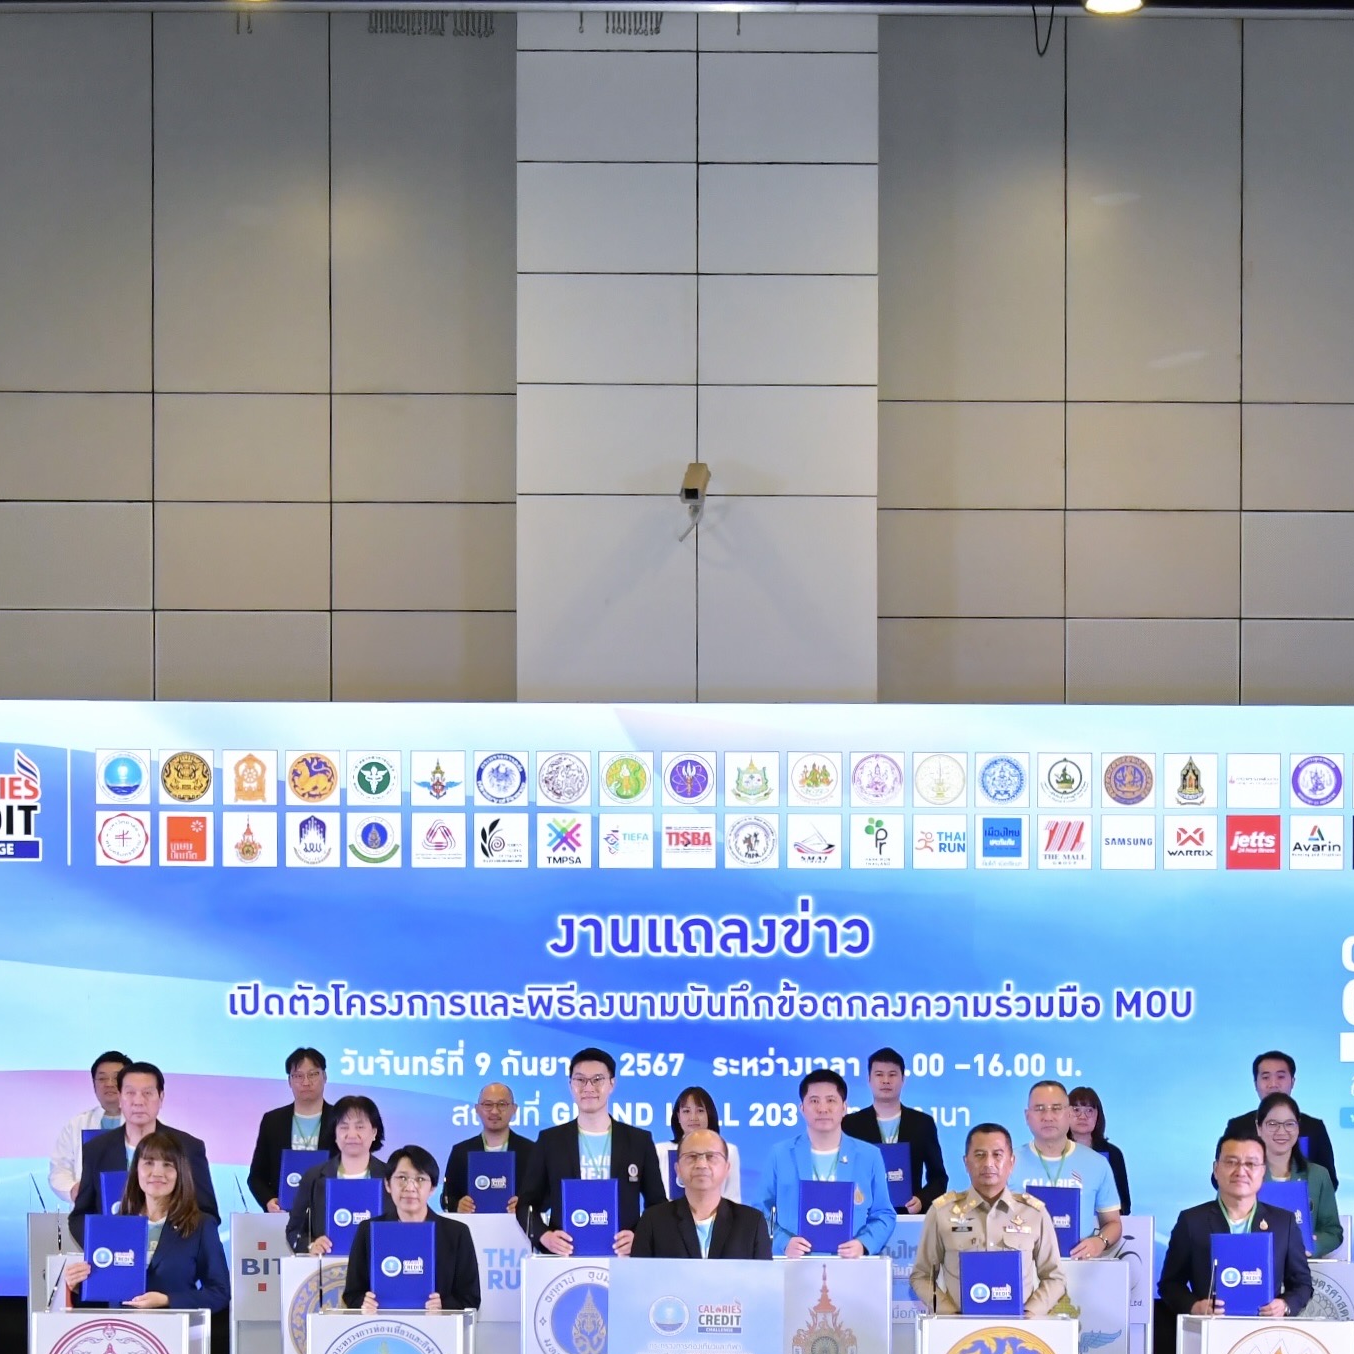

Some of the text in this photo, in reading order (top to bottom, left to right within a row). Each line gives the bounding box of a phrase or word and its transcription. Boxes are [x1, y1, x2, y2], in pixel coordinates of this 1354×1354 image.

[937, 831, 966, 842] THAI
[1104, 837, 1153, 846] SAMSUNG
[1230, 831, 1276, 850] jetts
[938, 842, 966, 853] RUN
[1167, 849, 1213, 857] WARRIX
[1292, 841, 1341, 852] Avarin
[546, 856, 582, 865] TMPSA
[549, 898, 871, 955] งานแถลงข่าว
[228, 980, 1193, 1019] เปิดตัวโครงการและพิธีลงนามบันทึกข้อตกลงความร่วมมือ MOU
[340, 1040, 464, 1077] วันจันทร์ที่
[475, 1053, 491, 1077] 9
[501, 1048, 571, 1077] กันยา
[620, 1053, 685, 1077] 2567
[551, 1102, 653, 1126] GND
[749, 1102, 798, 1127] 203
[483, 1248, 521, 1267] THA
[241, 1258, 282, 1275] BIT
[488, 1270, 521, 1289] RU
[698, 1315, 742, 1326] CREDIT
